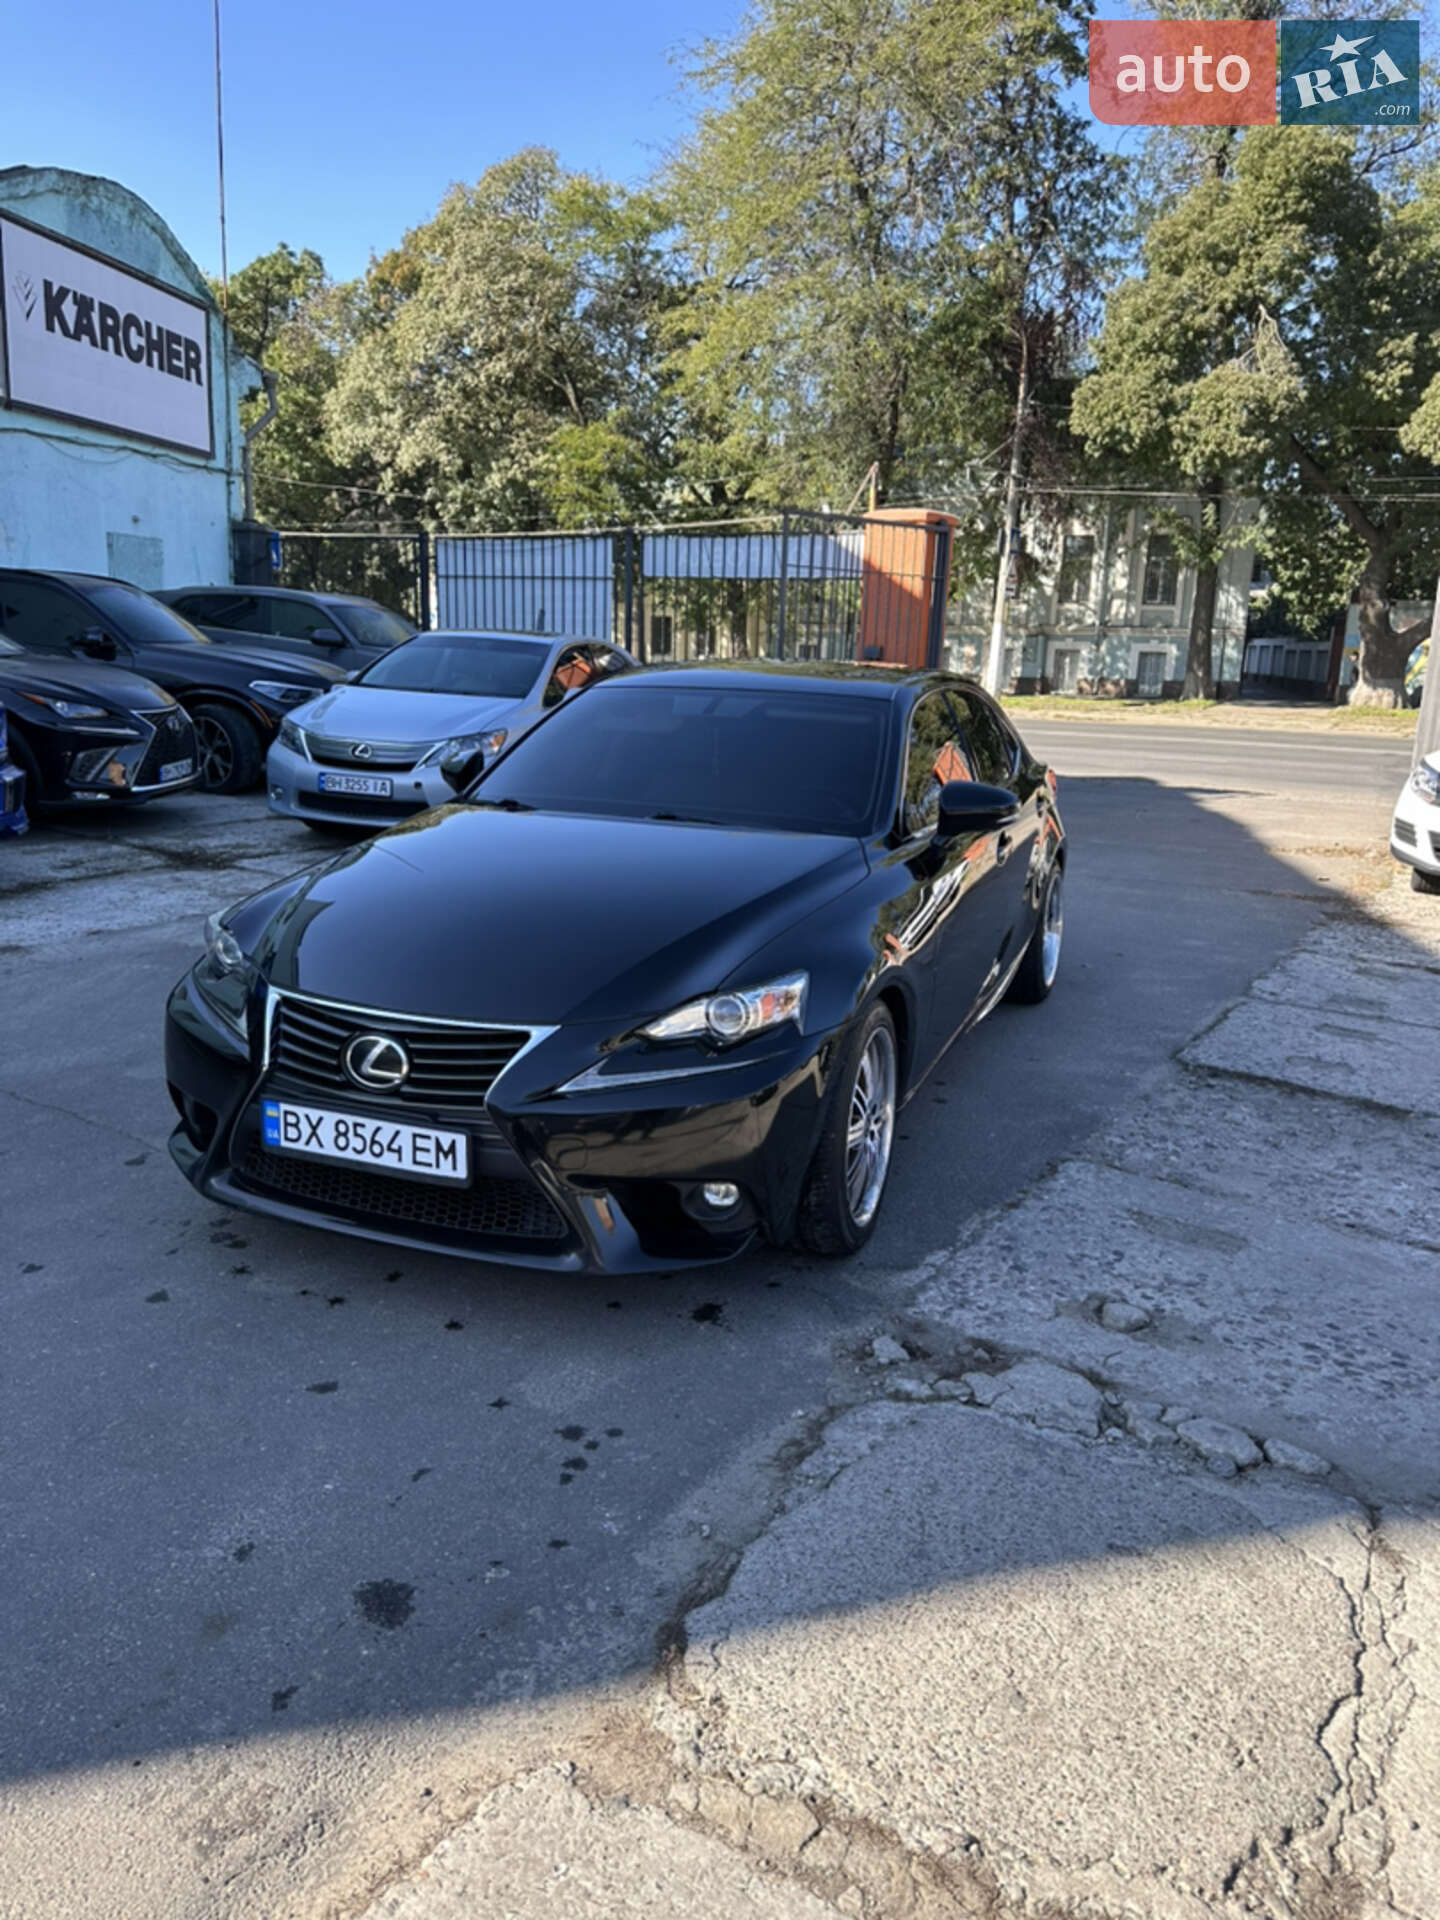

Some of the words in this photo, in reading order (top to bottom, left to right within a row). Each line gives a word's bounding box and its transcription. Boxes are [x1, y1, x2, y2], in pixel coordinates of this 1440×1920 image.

[43, 278, 203, 386] KÄRCHER
[283, 1110, 324, 1148] BX
[334, 1119, 403, 1163] 8564
[412, 1132, 458, 1171] EM
